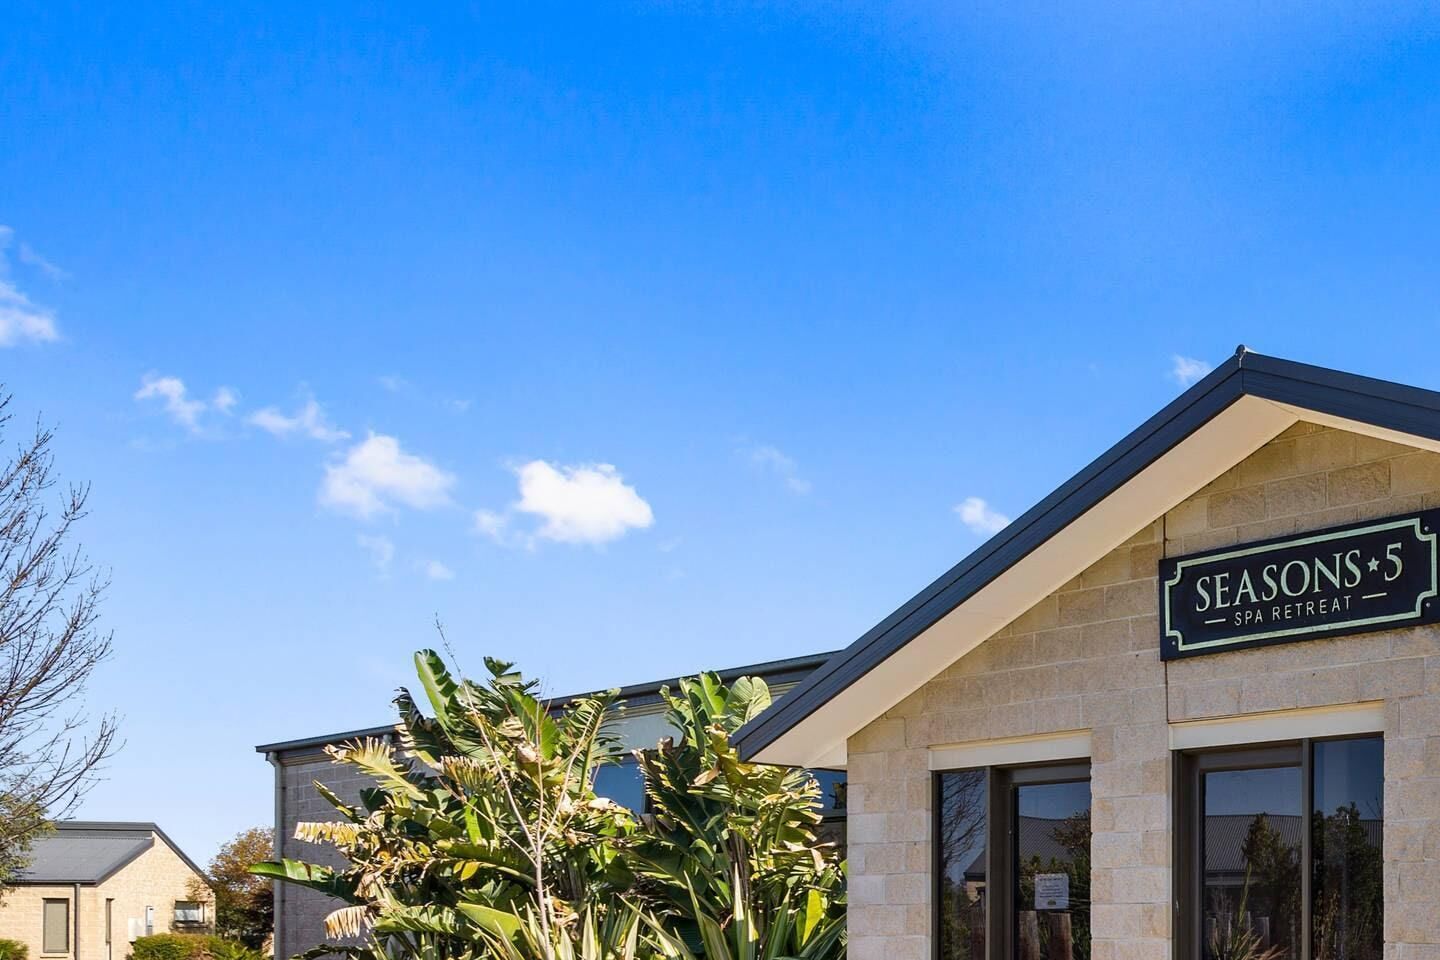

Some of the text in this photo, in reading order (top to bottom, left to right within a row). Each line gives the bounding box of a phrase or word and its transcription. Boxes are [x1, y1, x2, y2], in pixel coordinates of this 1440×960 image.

[1196, 542, 1403, 612] SEASONS 5
[1234, 595, 1352, 626] SPA RETREAT
